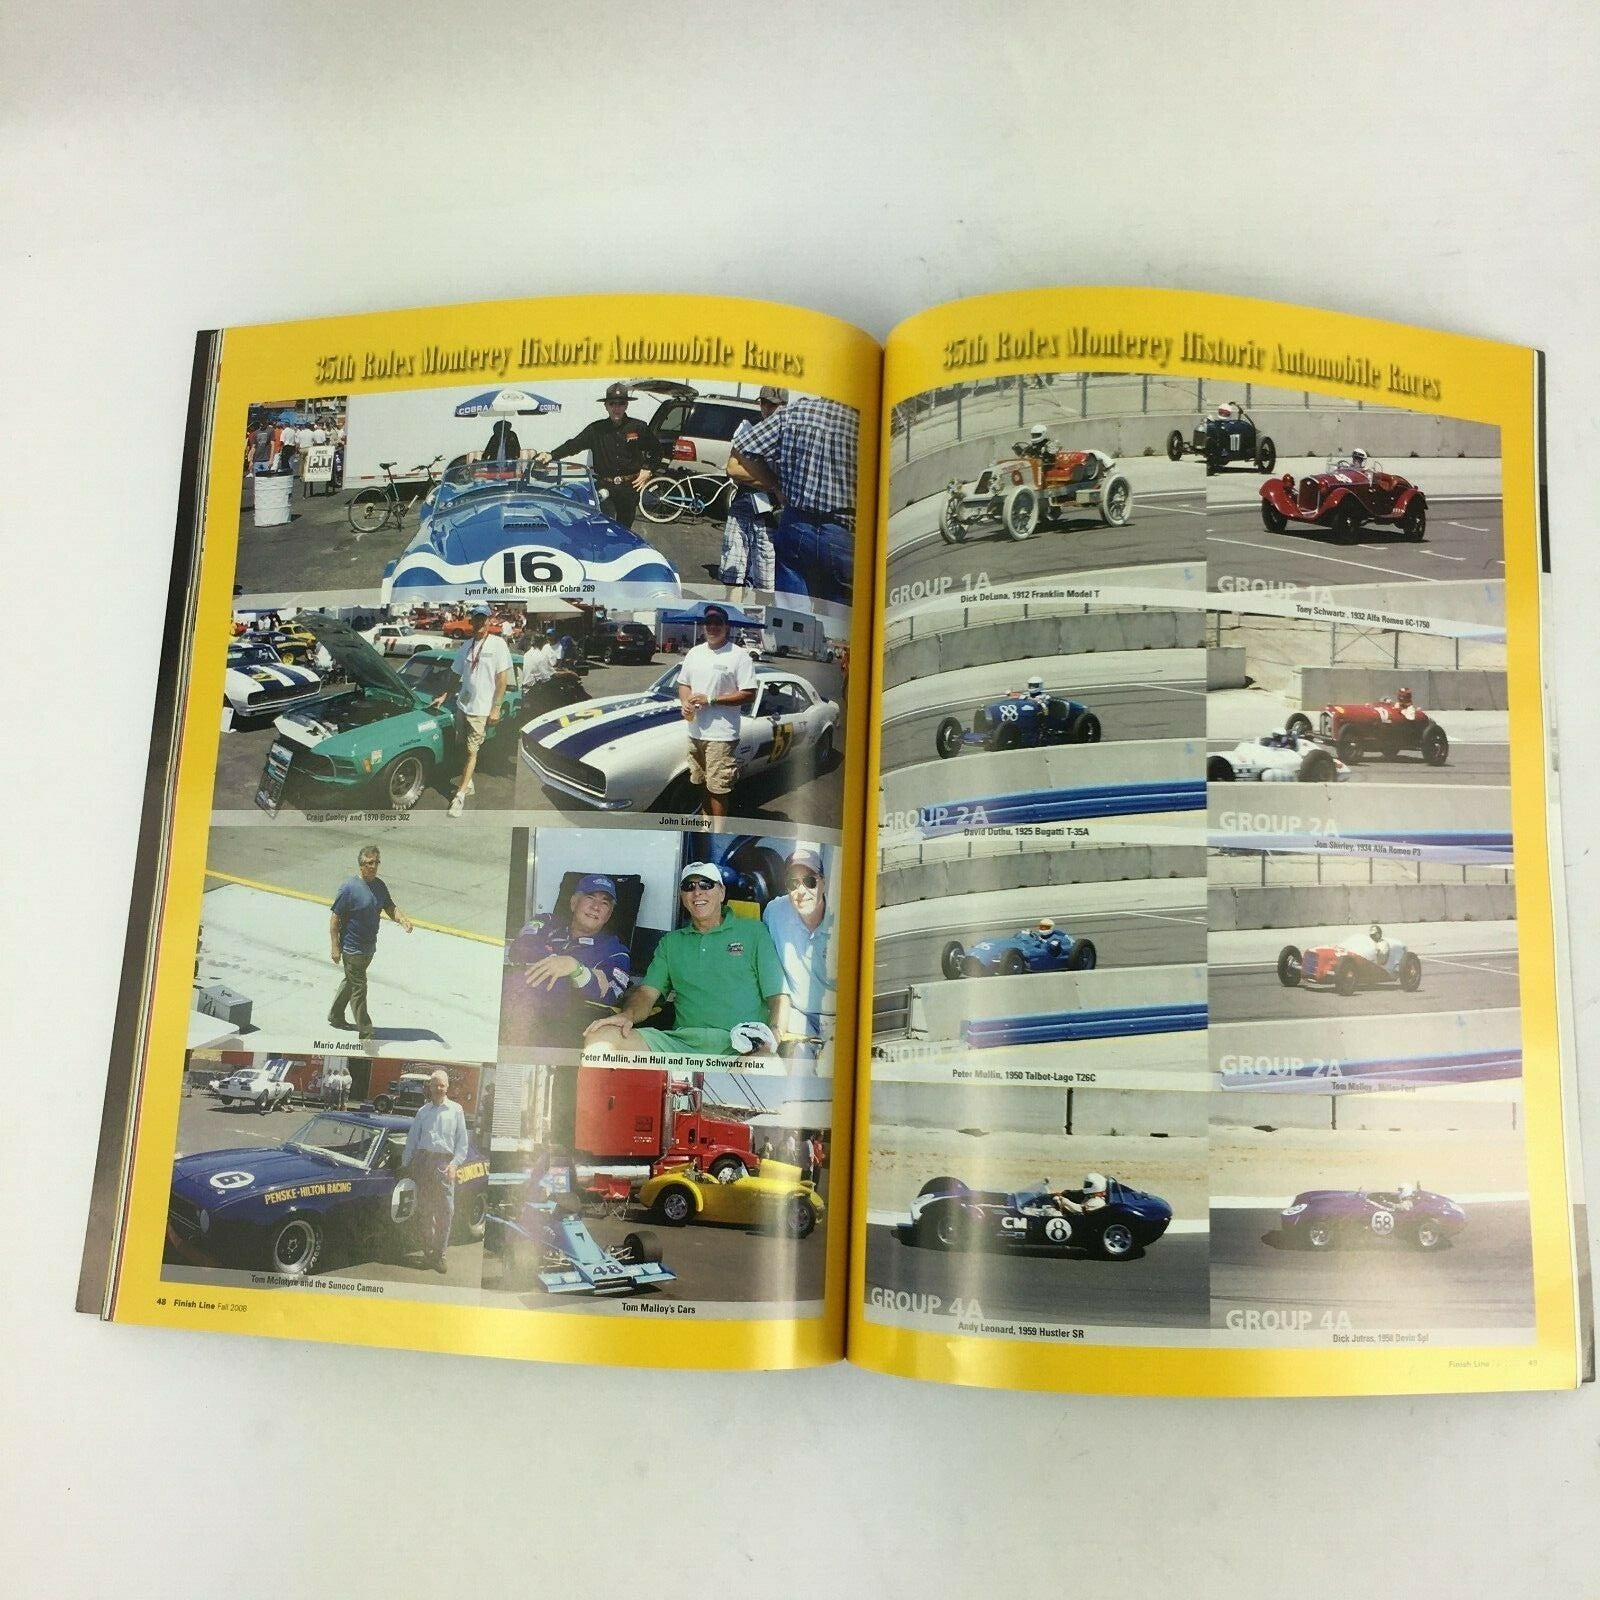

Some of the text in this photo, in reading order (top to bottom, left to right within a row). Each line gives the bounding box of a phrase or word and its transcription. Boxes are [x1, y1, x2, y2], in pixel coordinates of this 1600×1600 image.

[315, 334, 804, 384] 35th Rolex Monterey Historic Automobile Races
[944, 327, 1441, 400] 35th Rolex Monterey Historic Automobile Races
[458, 405, 489, 415] COBRA
[540, 404, 560, 413] COBRA
[310, 455, 331, 466] PIT
[503, 551, 564, 585] 16
[465, 584, 596, 596] Lynn Park and his 1964 FIA Cobra 289
[889, 571, 992, 607] GROUP 1A
[960, 590, 1100, 603] Dick DeLuna, 1912 Franklin Model T
[1296, 604, 1312, 615] Tony
[1313, 607, 1345, 617] Schwartz
[1351, 611, 1366, 620] 1932
[1367, 613, 1380, 622] Alfa
[1382, 615, 1404, 625] Romeo
[1000, 704, 1018, 721] 88
[306, 813, 324, 822] Craig
[349, 813, 362, 821] and
[364, 813, 379, 821] 1970
[380, 813, 396, 821] Boss
[398, 813, 410, 821] 302
[659, 817, 712, 828] John Linfesty
[884, 805, 989, 831] GROUP 2A
[1219, 811, 1340, 838] GROUP 2A
[964, 828, 985, 836] David
[1015, 827, 1033, 835] 1925
[1035, 827, 1064, 837] Bugatti
[1067, 827, 1089, 836] T-35A
[1389, 846, 1411, 855] Romeo
[313, 1041, 363, 1050] Mario Andretti
[580, 1053, 764, 1069] Peter Mullin, Jim Hull and Tony Schwartz relax
[1220, 1054, 1344, 1078] GROUP 2A
[952, 1069, 972, 1078] Peter
[1005, 1071, 1023, 1080] 1950
[1025, 1071, 1074, 1083] Talbot-Lago
[1076, 1073, 1096, 1082] T26C
[327, 1182, 352, 1195] RACING
[1001, 1216, 1028, 1229] CM
[1050, 1219, 1068, 1241] 8
[593, 1264, 624, 1276] 48
[251, 1274, 384, 1293] Tom McIntyre and the Sunoco Camaro
[174, 1299, 197, 1308] Finish
[199, 1301, 215, 1309] Line
[217, 1303, 229, 1311] Fall
[230, 1304, 247, 1312] 2008
[622, 1302, 696, 1314] Tom Malloy's Cars
[871, 1287, 984, 1319] GROUP 4A
[1226, 1309, 1351, 1330] GROUP 4A
[958, 1322, 1085, 1338] Andy Leonard, 1959 Hustler SR
[1333, 1334, 1349, 1343] Dick
